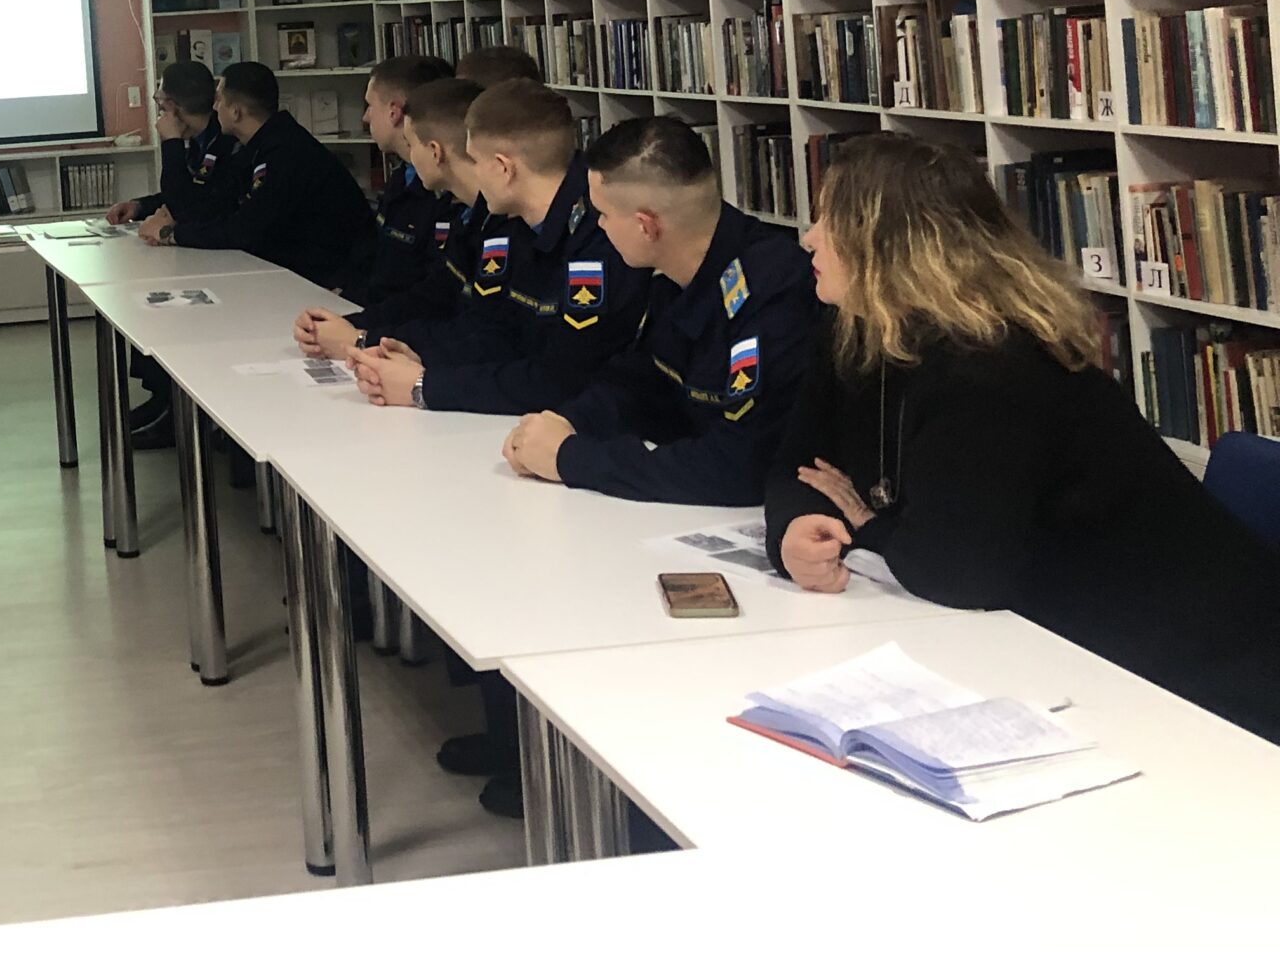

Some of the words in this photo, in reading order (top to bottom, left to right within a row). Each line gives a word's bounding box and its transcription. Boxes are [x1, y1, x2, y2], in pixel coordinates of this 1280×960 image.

[899, 86, 911, 104] Д
[1100, 98, 1114, 117] Ж
[1090, 254, 1103, 272] З
[1148, 269, 1163, 289] Л
